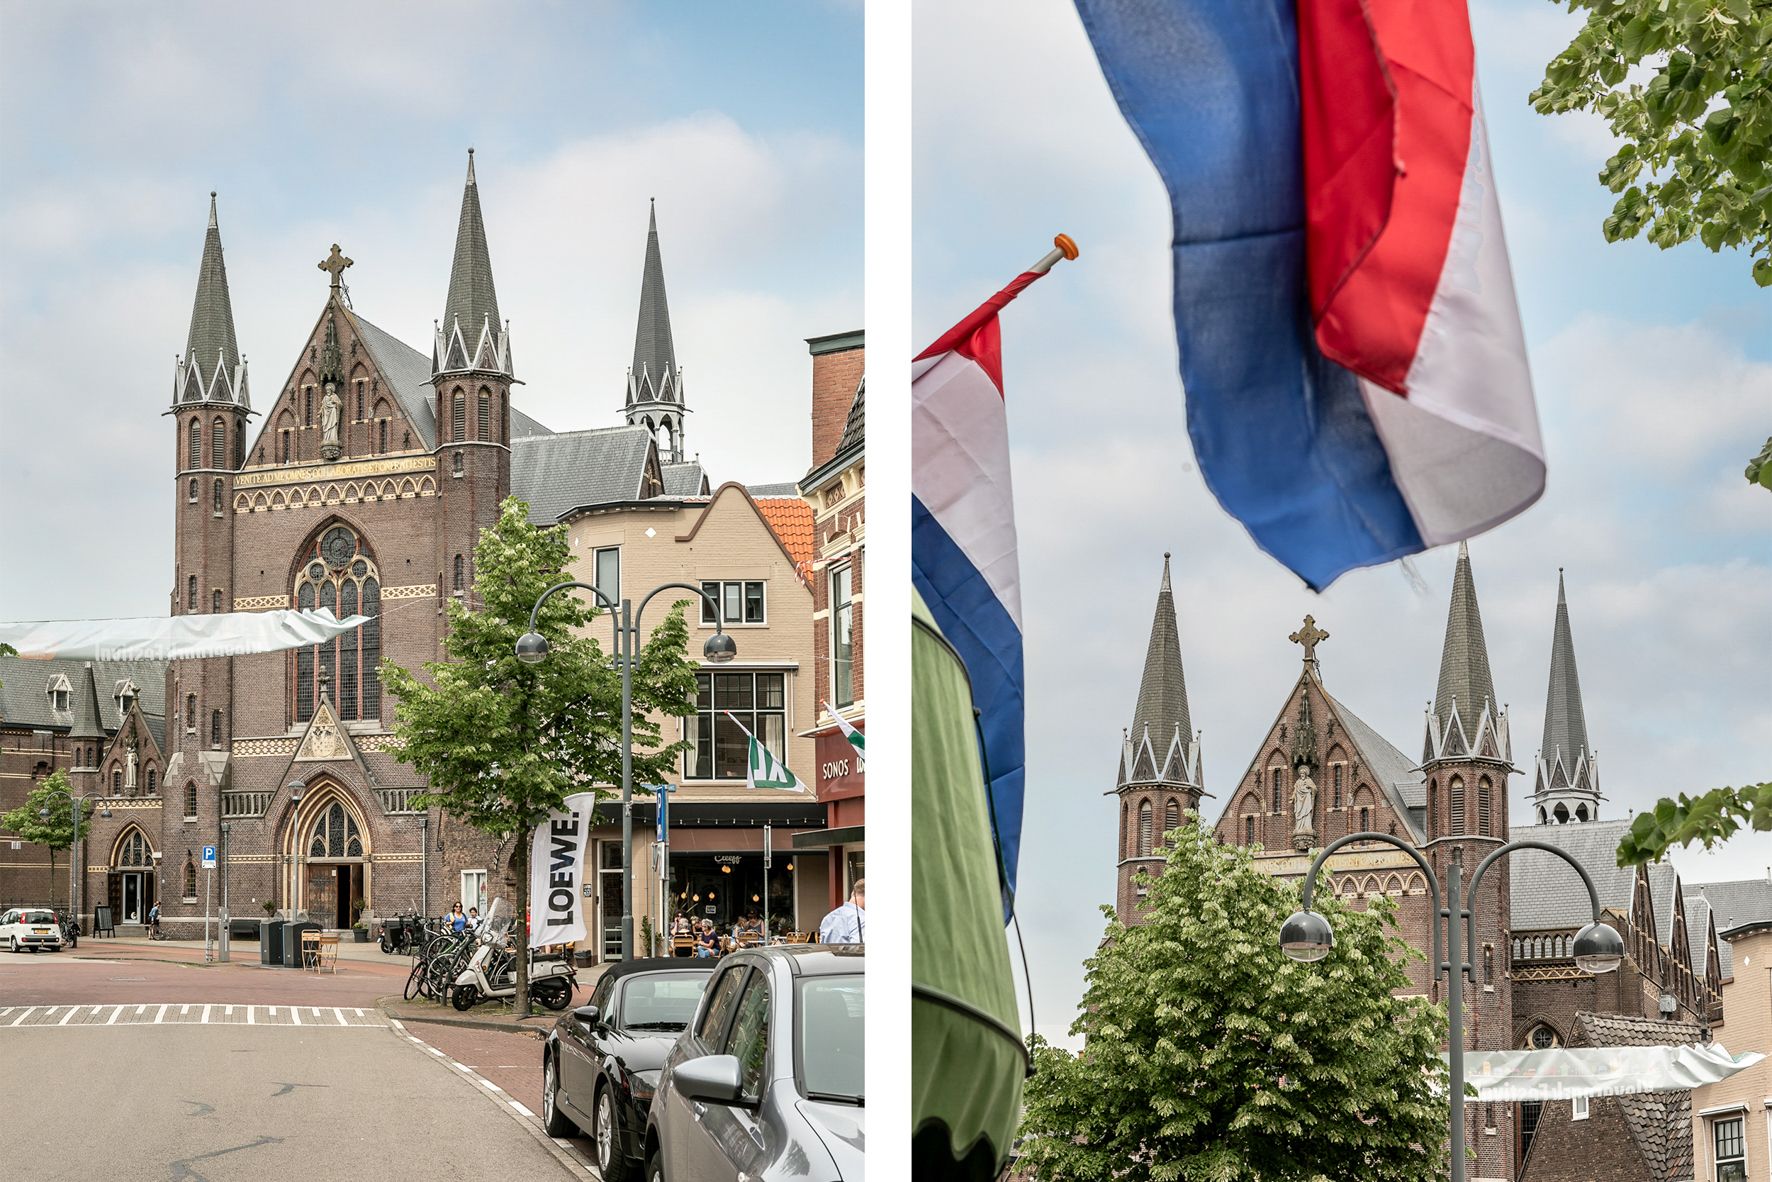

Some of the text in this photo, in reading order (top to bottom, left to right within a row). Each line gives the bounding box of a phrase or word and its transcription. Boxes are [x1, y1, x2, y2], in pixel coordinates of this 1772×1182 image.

[262, 472, 273, 483] AD
[822, 758, 849, 780] SONOS
[205, 848, 213, 859] P
[547, 811, 580, 926] LOEWE.
